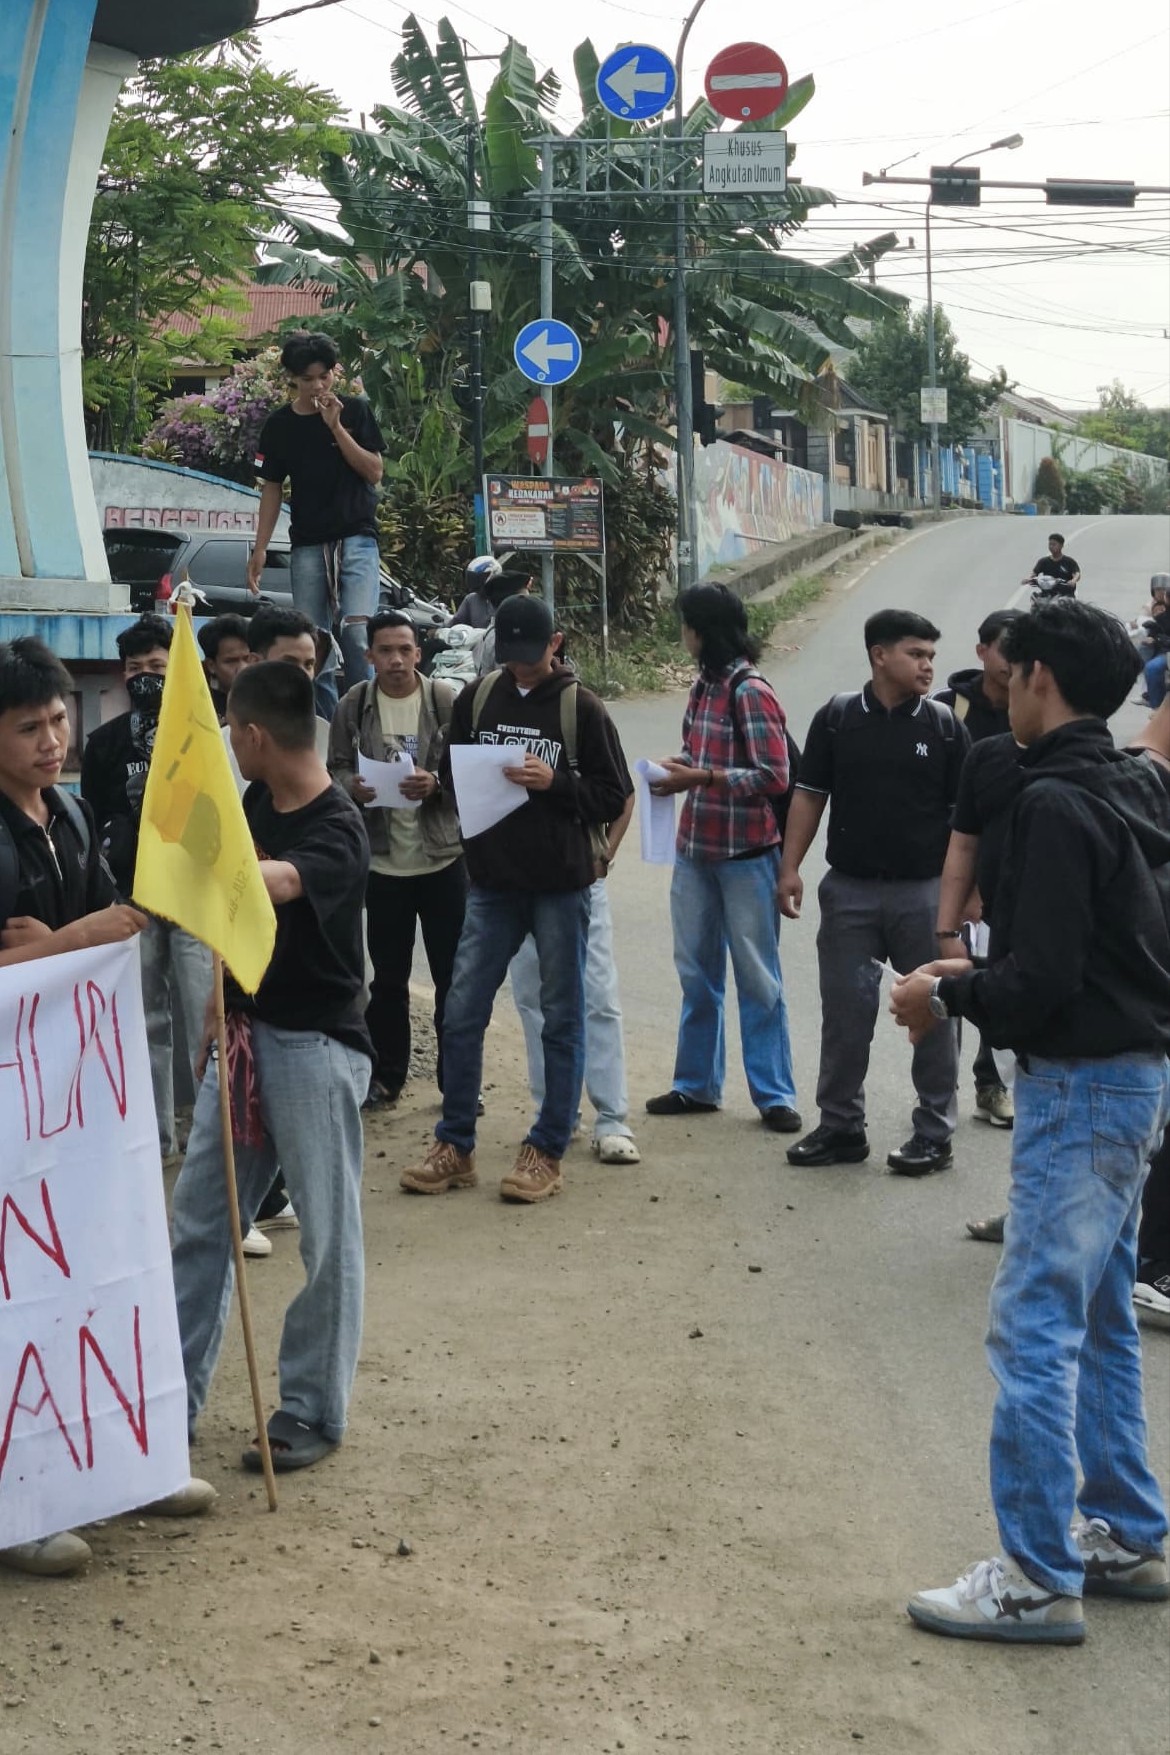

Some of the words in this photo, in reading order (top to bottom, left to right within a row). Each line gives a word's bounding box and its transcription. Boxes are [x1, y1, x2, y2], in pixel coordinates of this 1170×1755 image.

[728, 137, 763, 156] Khusus
[709, 164, 753, 188] Angkutan
[754, 164, 782, 184] Umum
